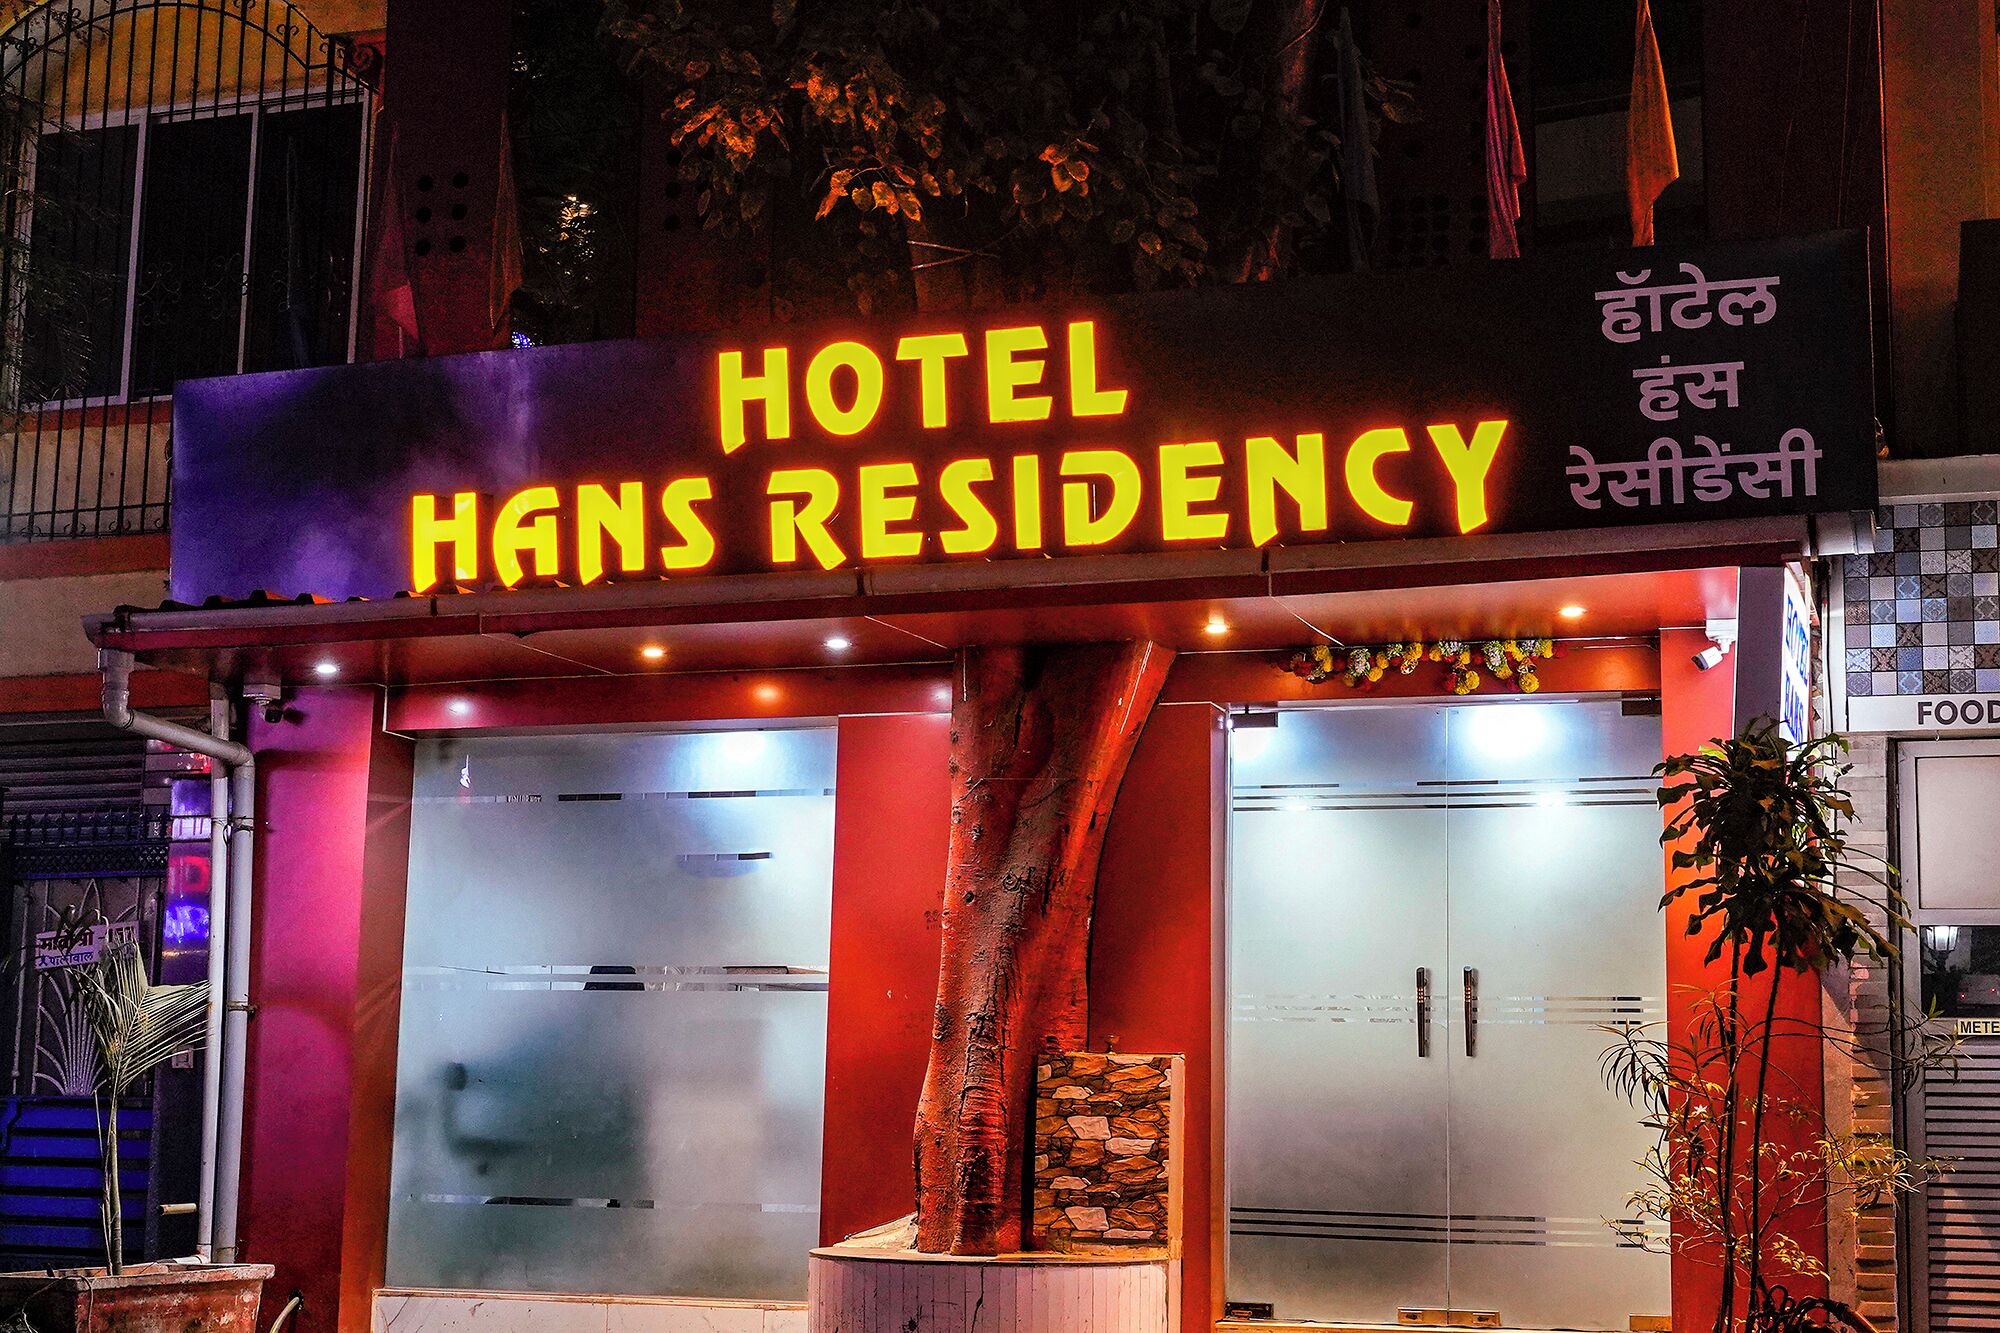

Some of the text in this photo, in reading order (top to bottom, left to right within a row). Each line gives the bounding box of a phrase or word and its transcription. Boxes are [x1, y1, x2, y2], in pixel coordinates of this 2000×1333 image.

[1594, 262, 1780, 343] हॉटेल
[718, 320, 1129, 455] HOTEL
[1632, 355, 1744, 421] हंस
[411, 419, 1509, 594] HANS RESIDENCY
[1566, 428, 1822, 509] रेसीडेंसी
